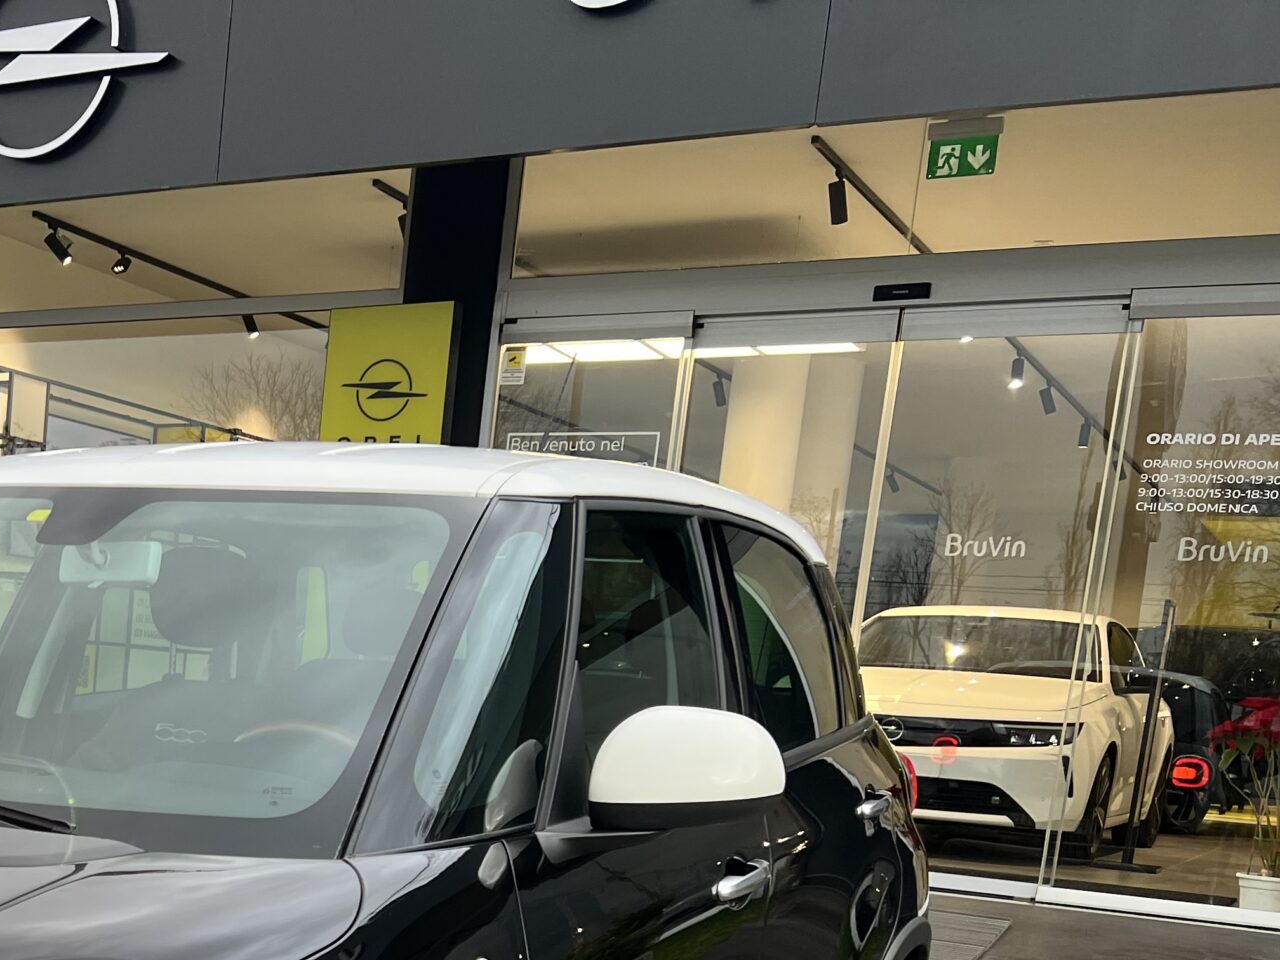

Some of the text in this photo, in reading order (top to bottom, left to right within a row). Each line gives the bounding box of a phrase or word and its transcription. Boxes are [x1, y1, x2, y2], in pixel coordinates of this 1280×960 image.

[600, 436, 625, 452] nel
[1146, 433, 1217, 445] ORARIO
[1220, 433, 1241, 446] DI
[1142, 459, 1279, 470] ORARIO SHOWROOM
[1135, 501, 1259, 514] CHIUSO DOMENICA
[944, 533, 1026, 558] BruVin
[1177, 536, 1269, 563] BruVin
